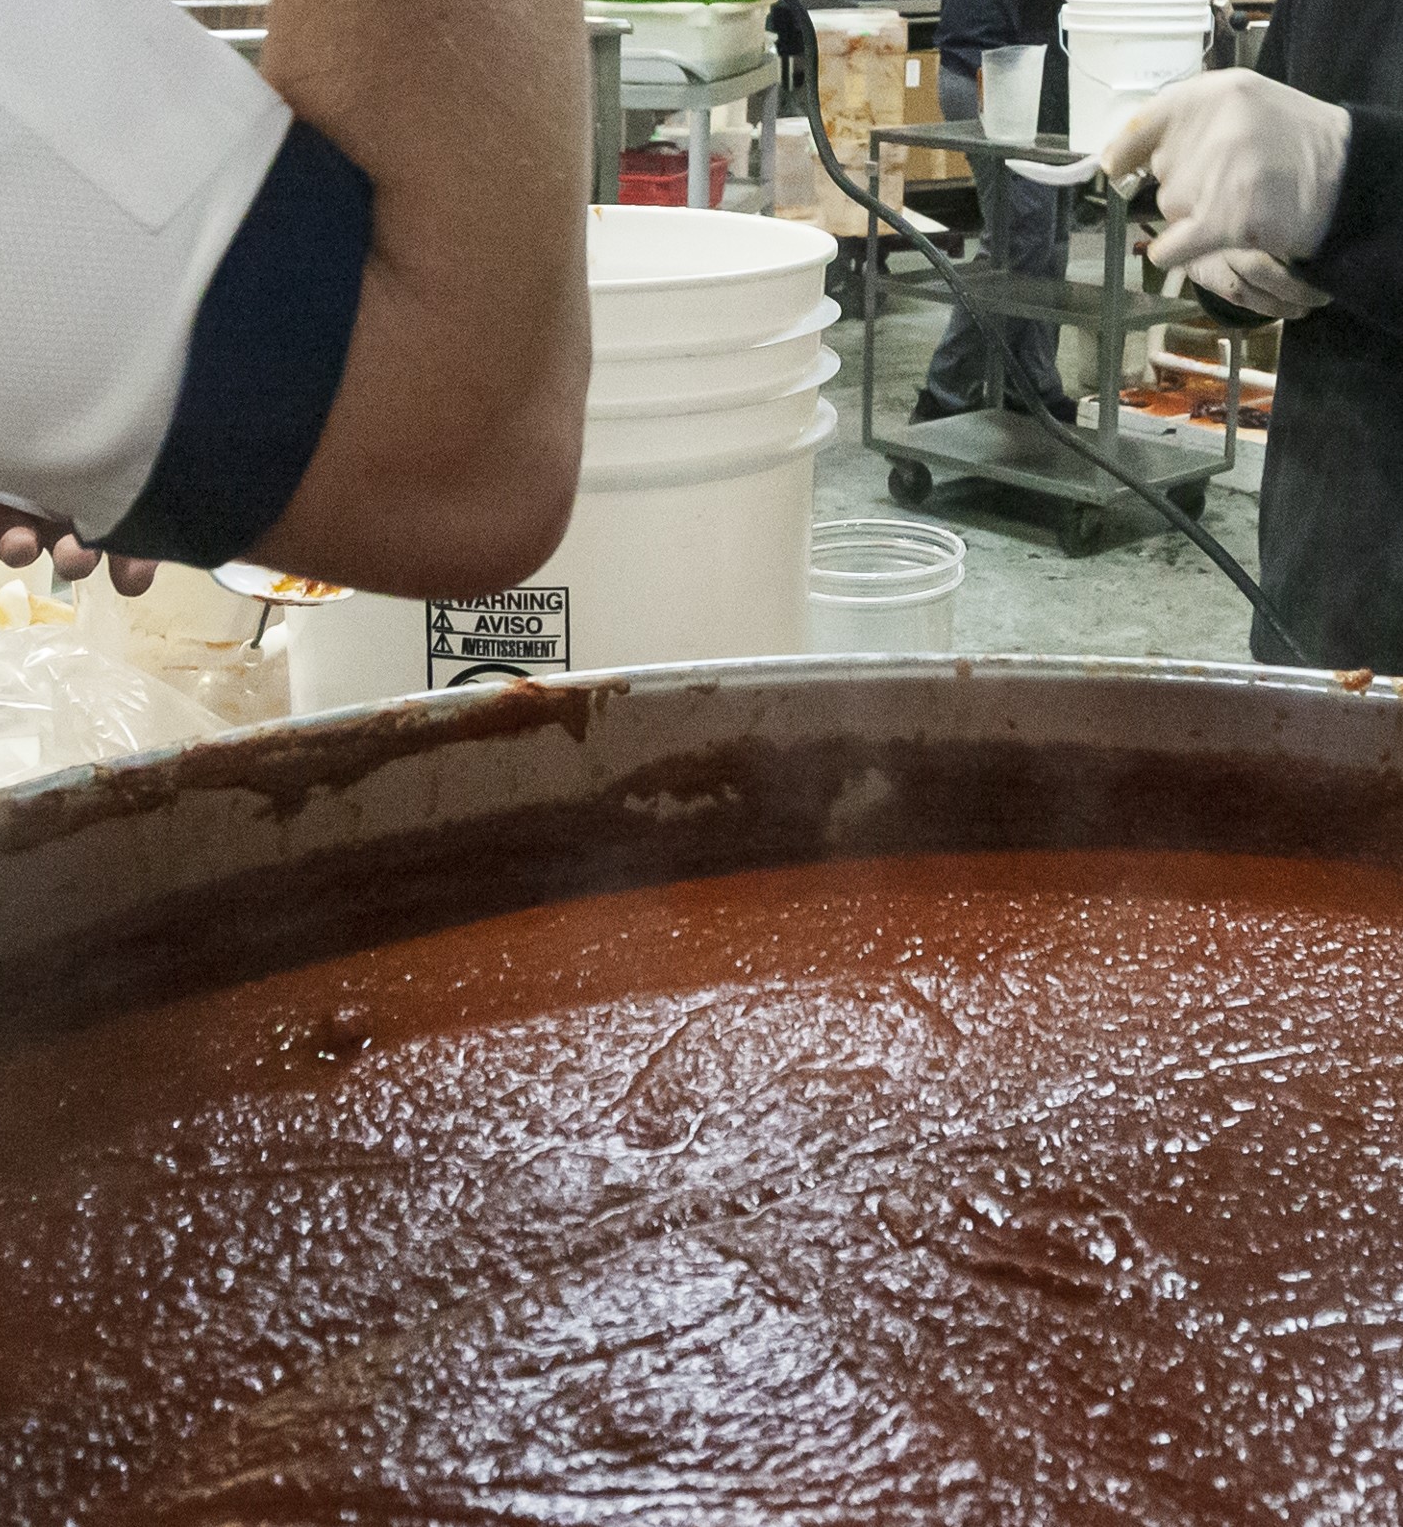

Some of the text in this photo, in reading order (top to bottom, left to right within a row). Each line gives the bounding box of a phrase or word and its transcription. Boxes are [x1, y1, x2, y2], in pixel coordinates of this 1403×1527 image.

[455, 592, 563, 611] WARNING
[475, 615, 543, 634] AVISO
[461, 637, 557, 658] AVERTISSEMENT
